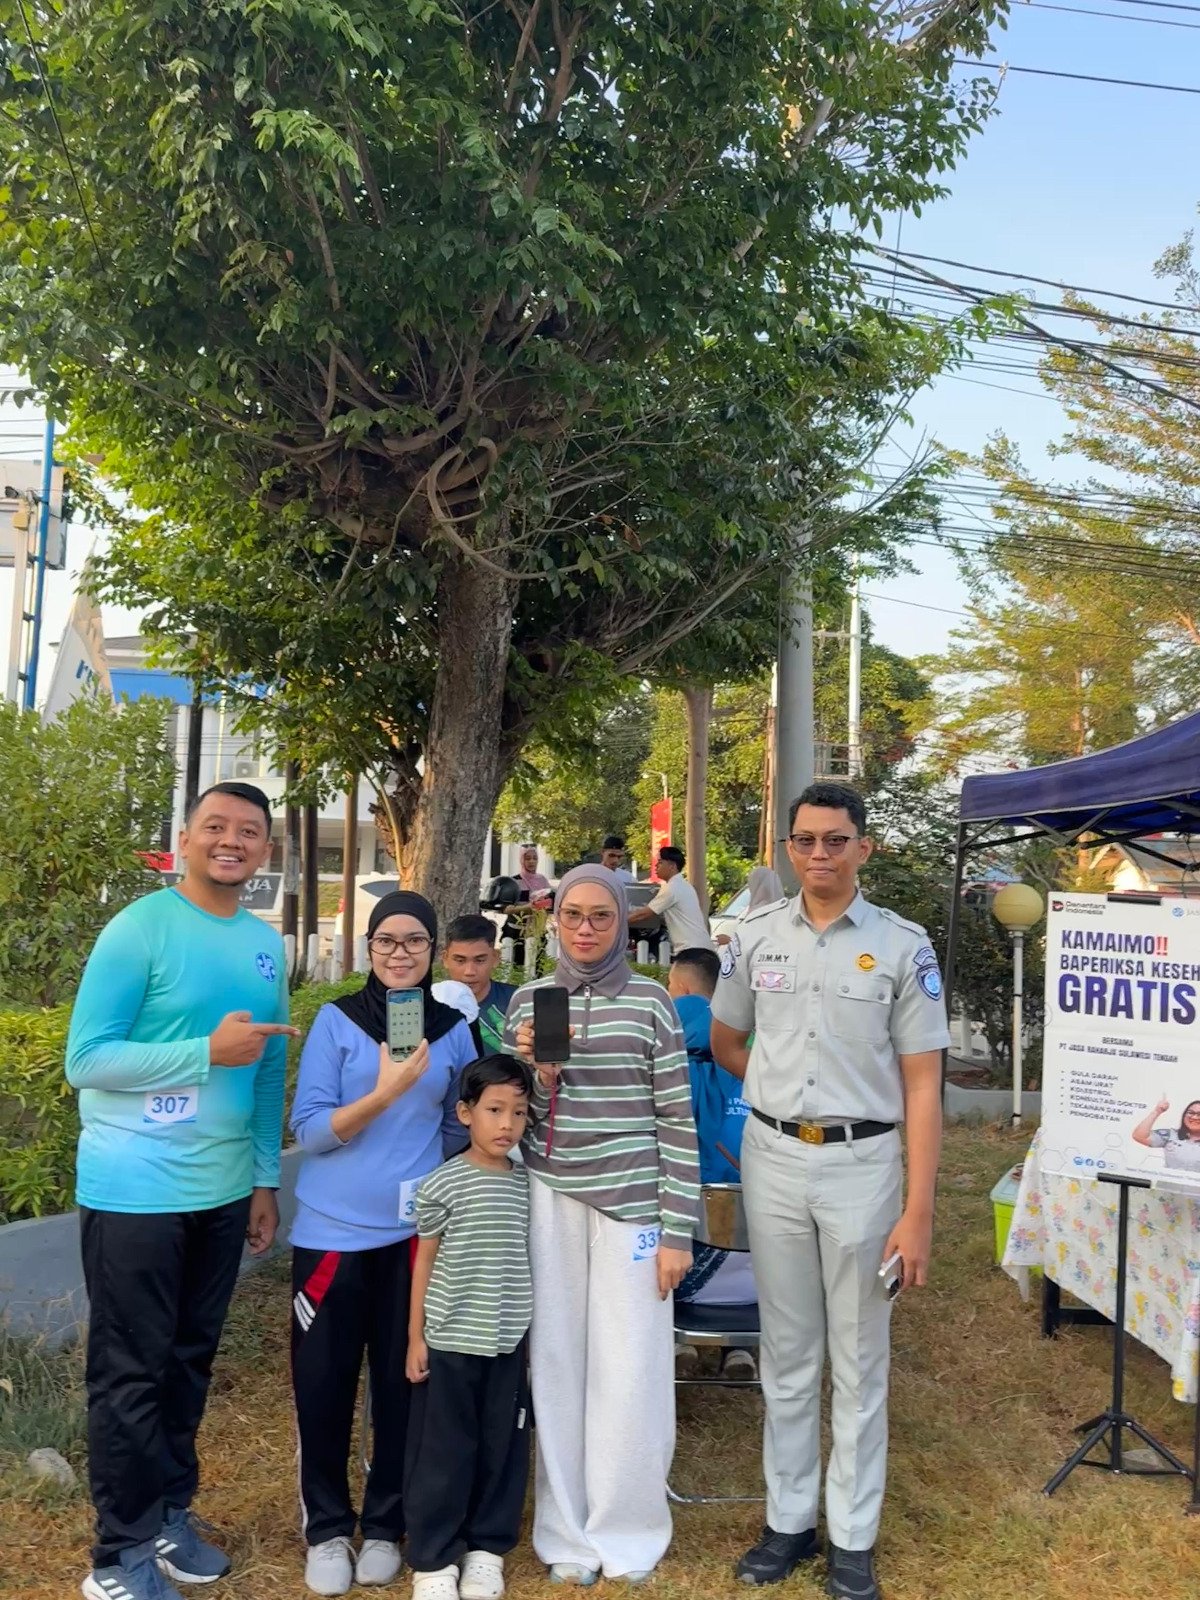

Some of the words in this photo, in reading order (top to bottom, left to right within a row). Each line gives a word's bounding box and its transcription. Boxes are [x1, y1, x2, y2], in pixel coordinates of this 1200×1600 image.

[1062, 930, 1168, 956] KAMAIMO!!
[758, 954, 789, 963] JIMMY
[1060, 954, 1144, 977] BAPERIKSA
[1151, 961, 1200, 981] KESEH
[1058, 973, 1196, 1025] GRATIS
[151, 1096, 190, 1114] 307
